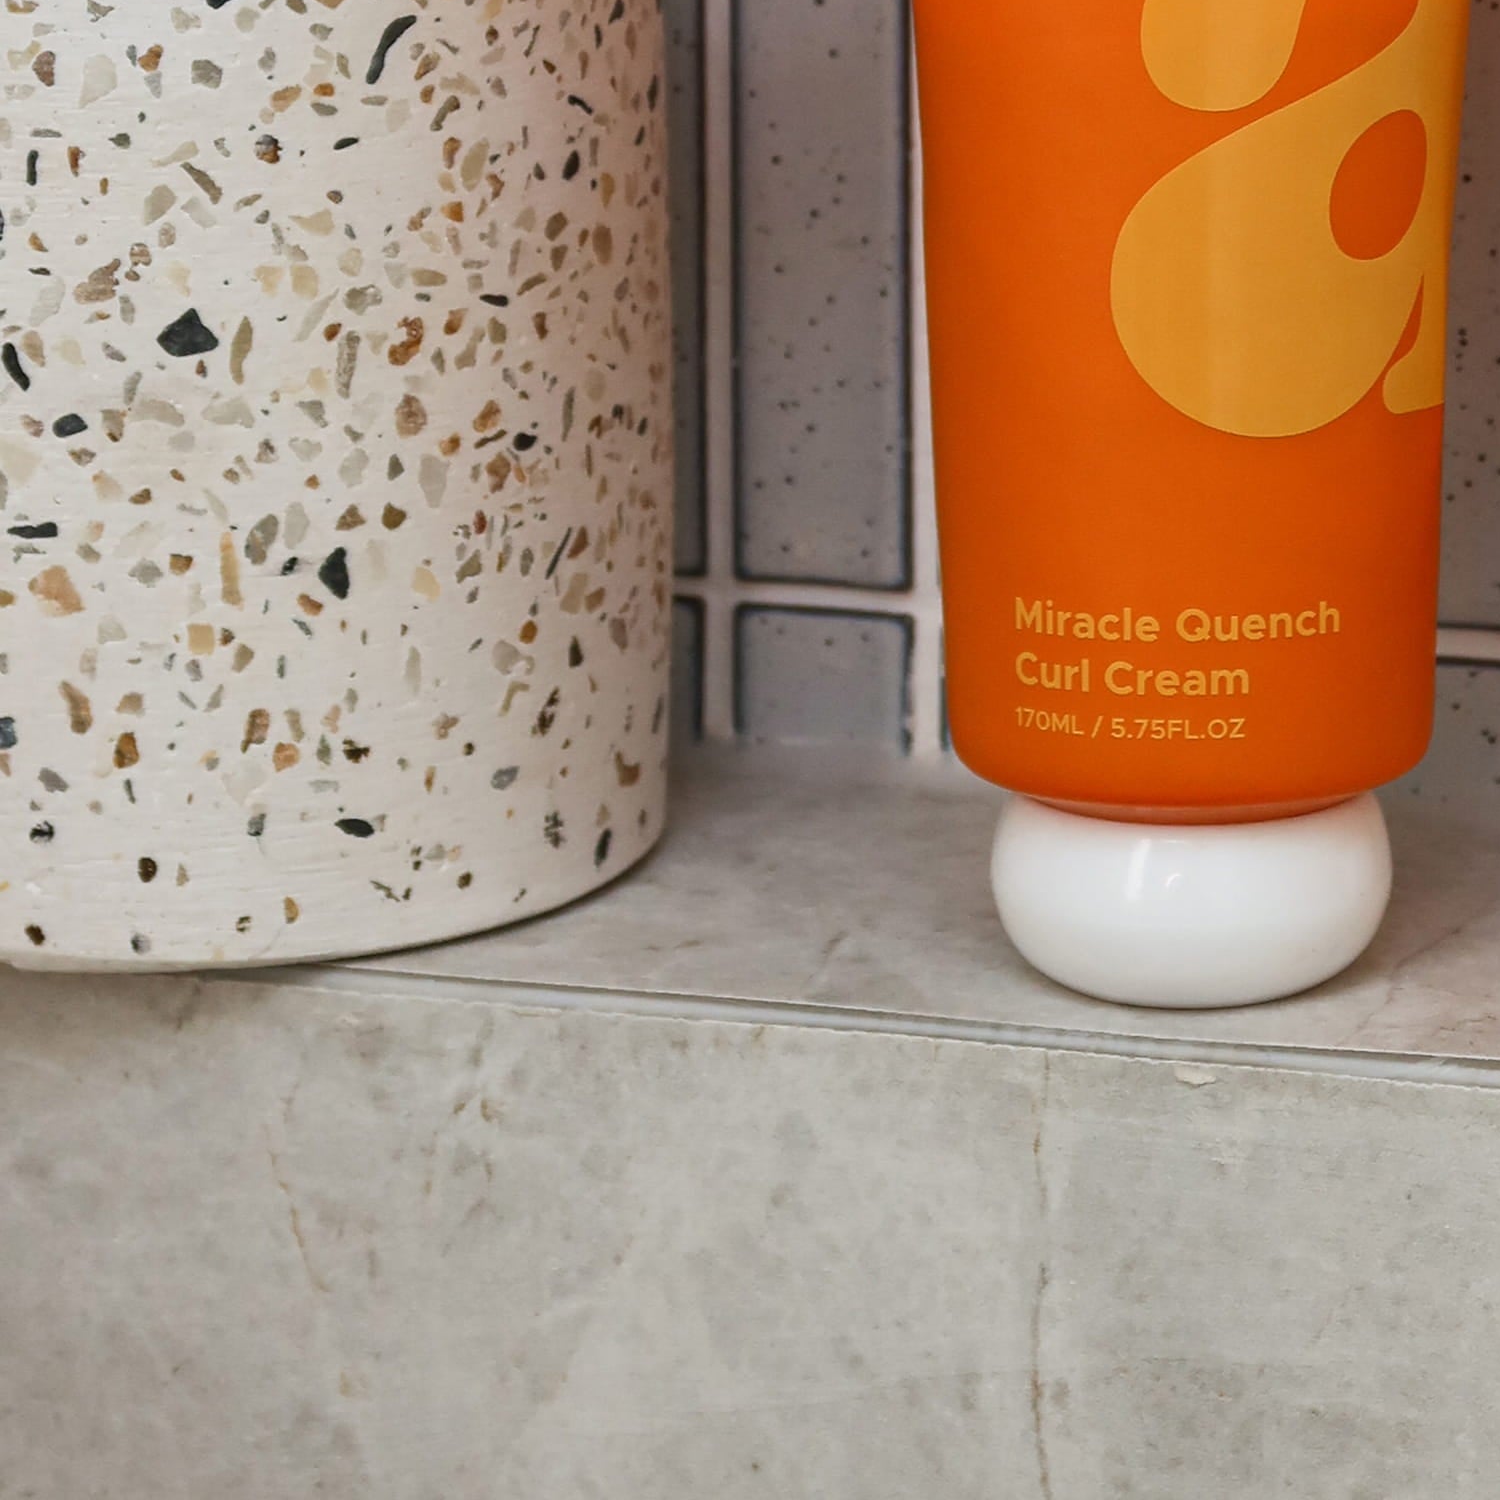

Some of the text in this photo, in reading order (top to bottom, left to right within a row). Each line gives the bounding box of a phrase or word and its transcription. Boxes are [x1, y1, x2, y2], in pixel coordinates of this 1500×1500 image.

[1014, 596, 1341, 642] Miracle Quench
[1015, 652, 1250, 696] Curl Cream
[1015, 706, 1085, 735] 170ML
[1110, 718, 1247, 740] 5.75FL.OZ
